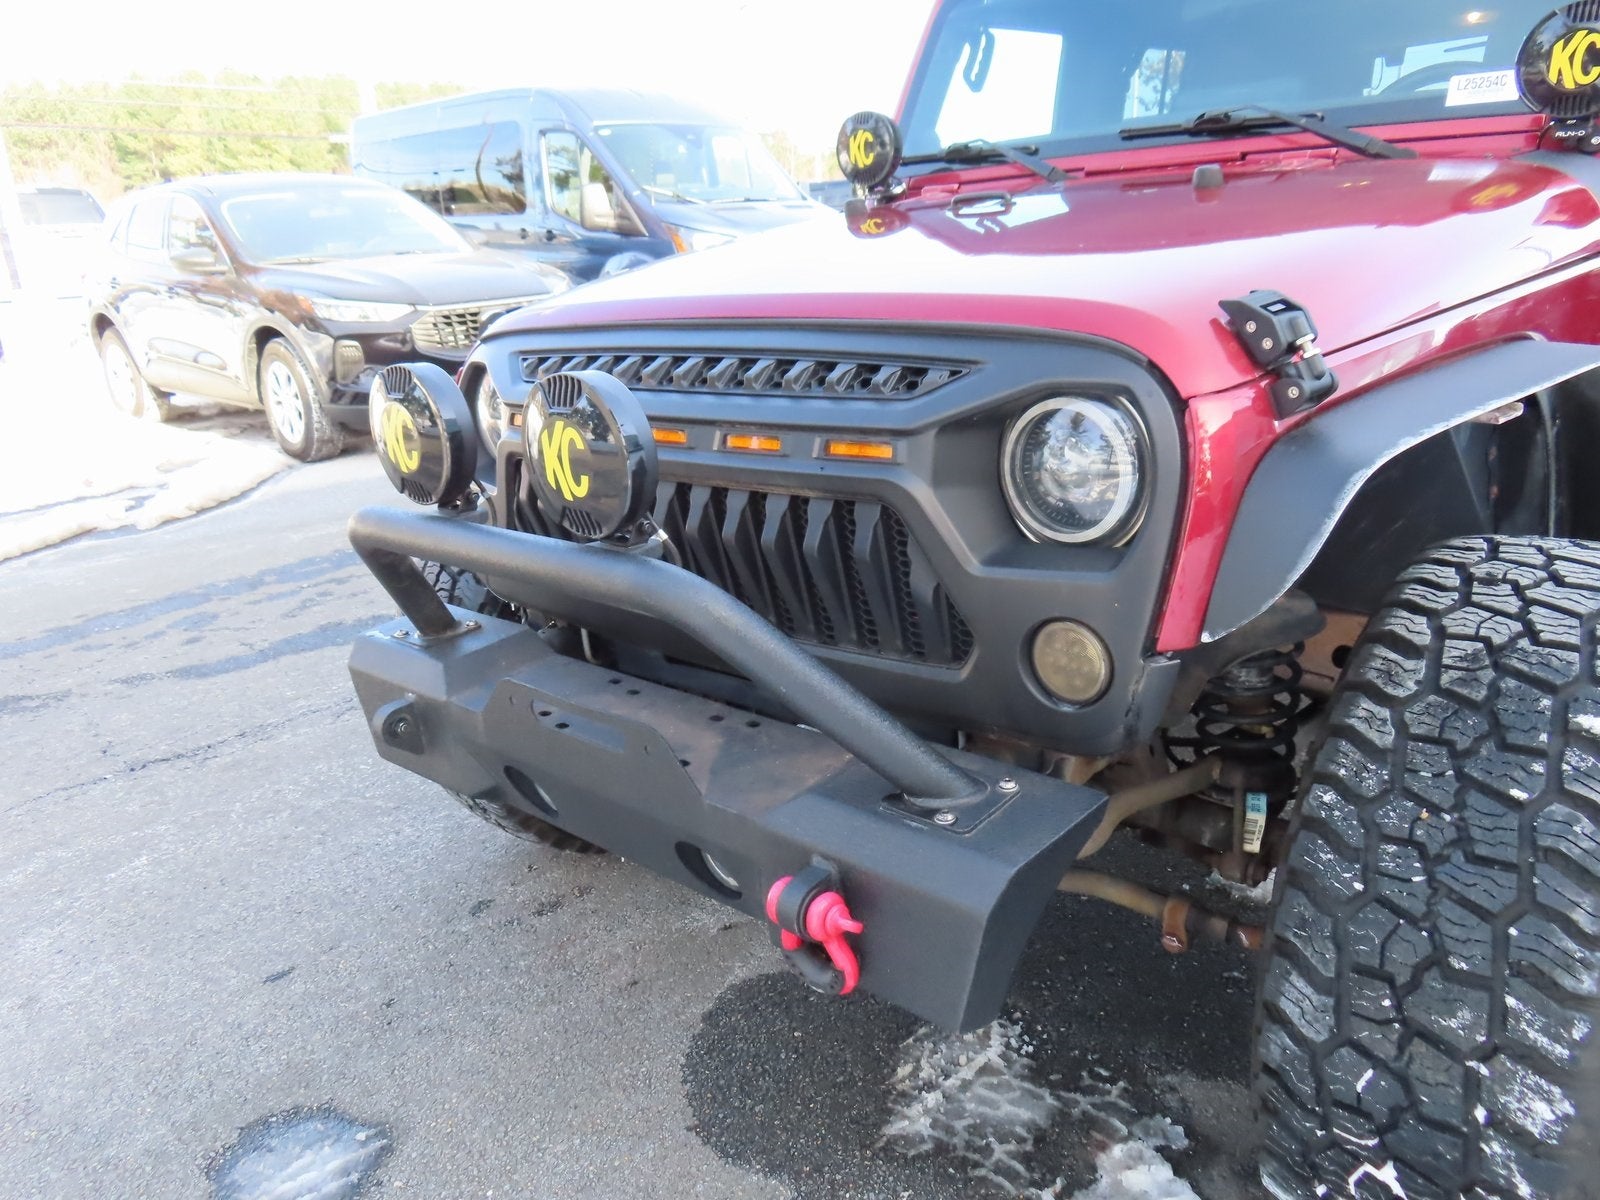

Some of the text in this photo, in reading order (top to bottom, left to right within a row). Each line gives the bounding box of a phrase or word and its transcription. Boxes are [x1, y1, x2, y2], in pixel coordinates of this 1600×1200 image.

[1456, 73, 1508, 91] L25254C
[1548, 29, 1600, 89] KC
[849, 129, 874, 169] KC
[381, 403, 419, 474] KC
[541, 420, 590, 502] KC
